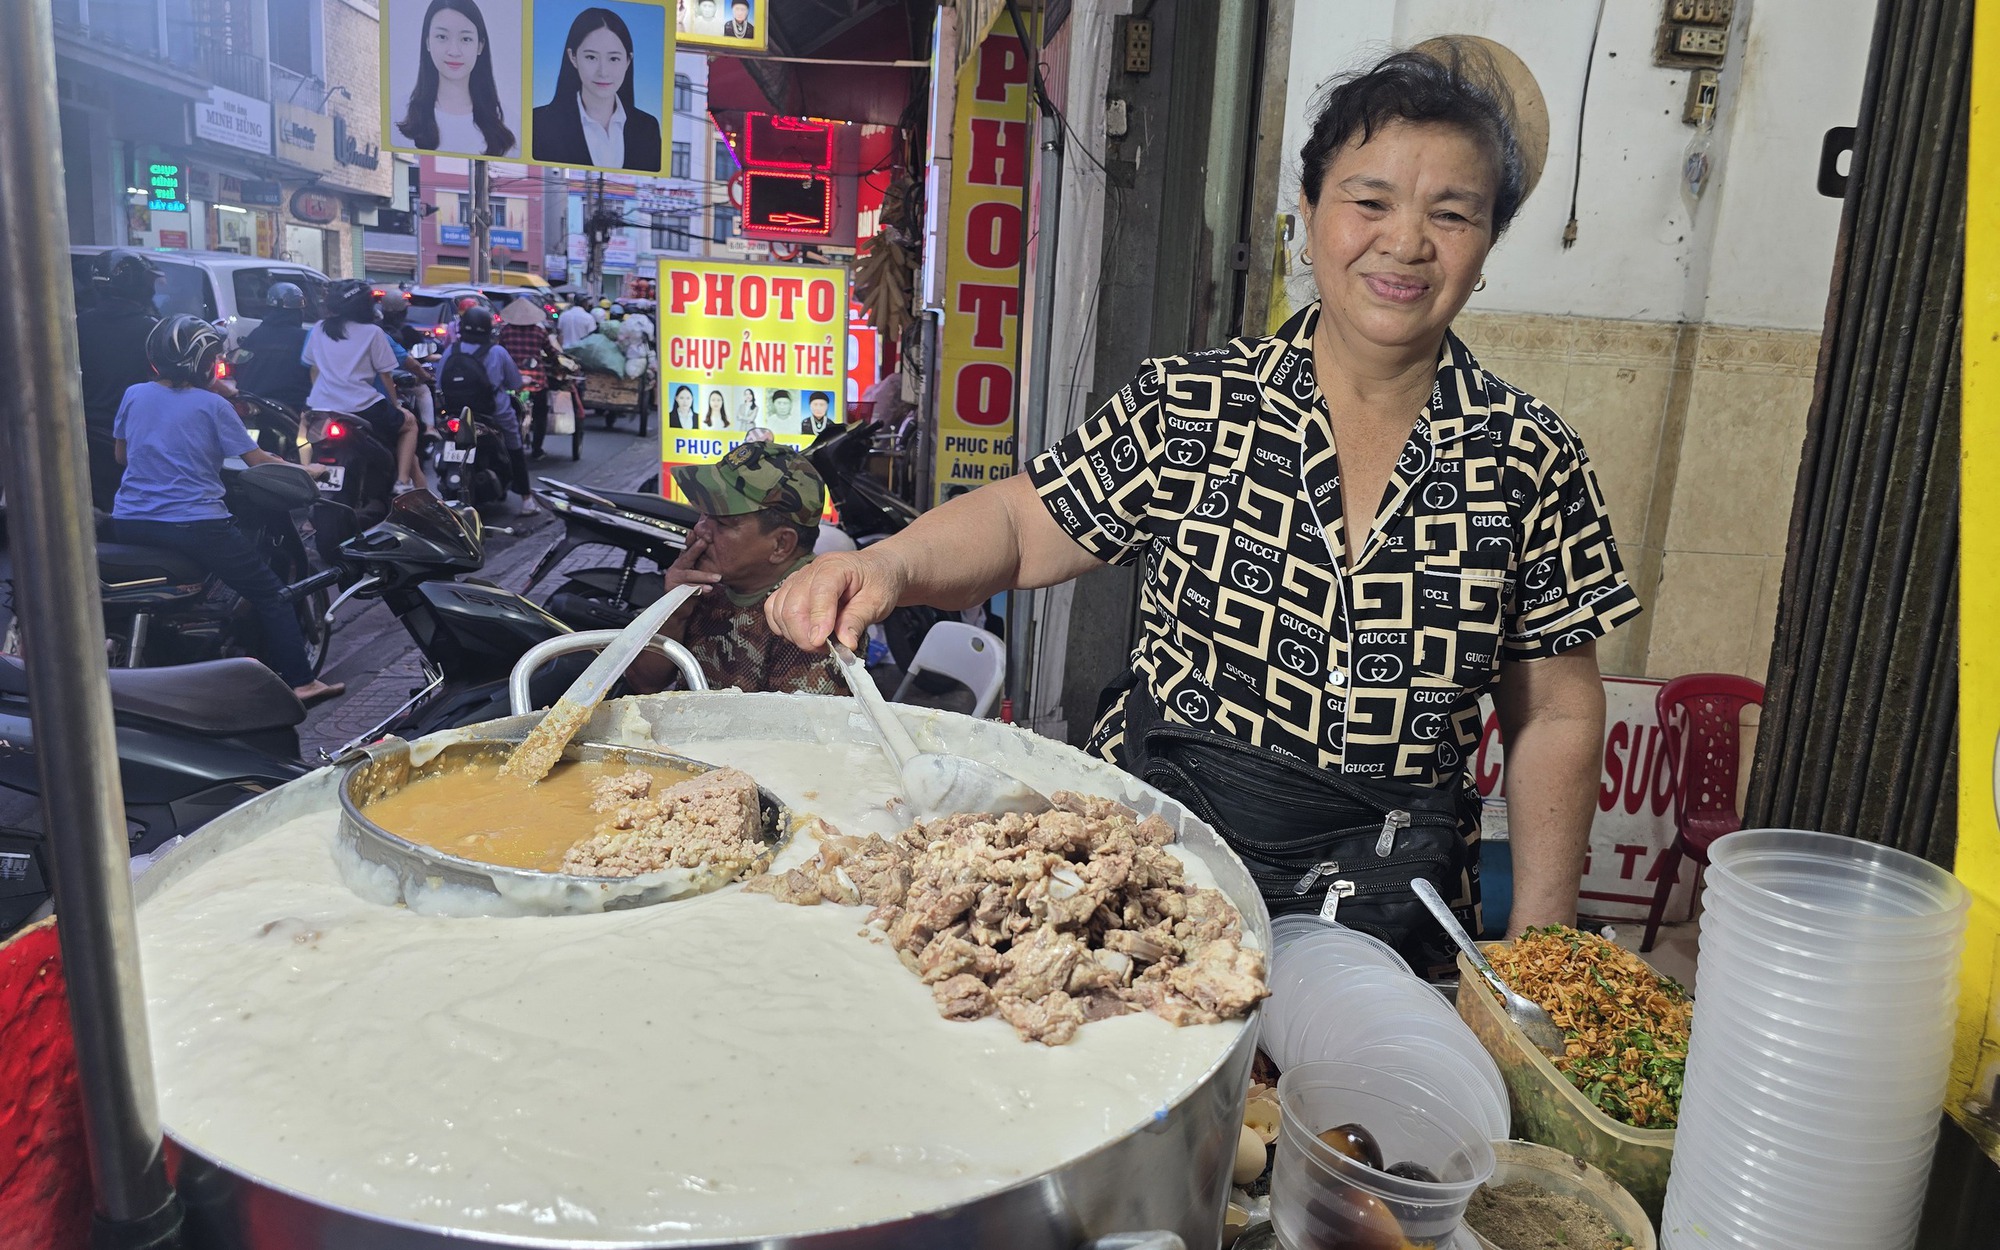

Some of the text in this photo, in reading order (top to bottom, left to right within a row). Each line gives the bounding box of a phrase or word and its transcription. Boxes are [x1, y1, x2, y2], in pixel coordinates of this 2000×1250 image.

[206, 108, 233, 129] MINH
[955, 34, 1028, 427] PHOTO
[670, 271, 835, 323] PHOTO
[670, 331, 834, 377] CHỤP ẢNH THẺ
[1272, 350, 1299, 386] GUCCI
[1121, 383, 1137, 413] GUCCI
[1231, 392, 1256, 403] GUC
[1168, 416, 1213, 432] GUCCI
[675, 438, 722, 458] PHỤC
[945, 435, 1013, 457] PHỤC HỒ
[951, 458, 1010, 481] ẢNH CŨ
[1255, 447, 1292, 469] GUCCI
[1090, 451, 1115, 491] GUCCI
[1314, 475, 1341, 498] GUCC
[1056, 497, 1081, 530] GUCCI
[1472, 515, 1511, 528] GUCC
[1301, 522, 1324, 539] GUC
[1234, 535, 1281, 564] GUCCI
[1186, 587, 1211, 610] GUCCI
[1279, 613, 1326, 645] GUCCI
[1358, 632, 1407, 645] GUCCI
[1465, 652, 1491, 664] GUCCI
[1192, 667, 1214, 691] GUC
[1225, 662, 1257, 688] GUCCI
[1344, 763, 1385, 773] GUCCI
